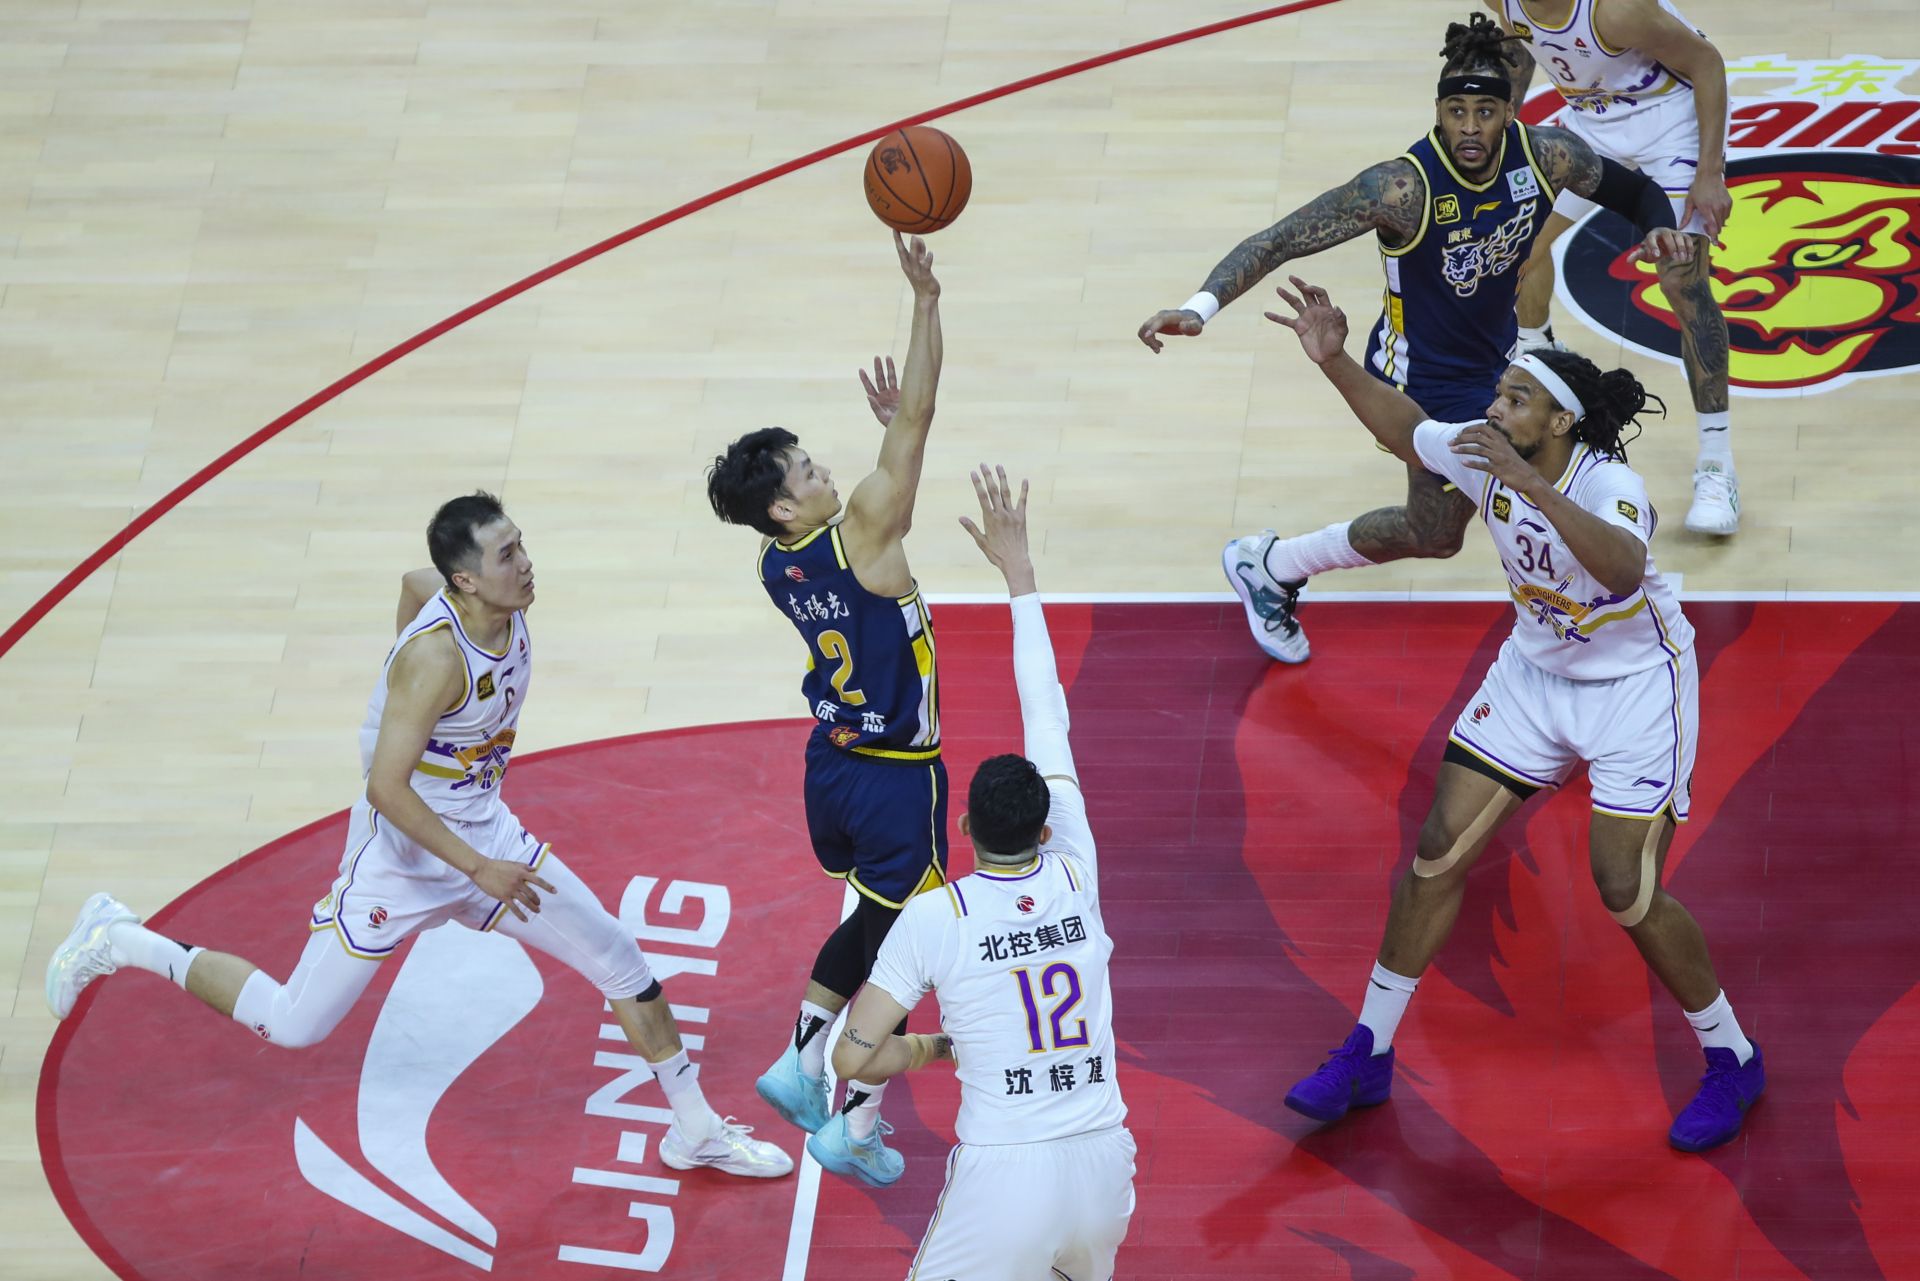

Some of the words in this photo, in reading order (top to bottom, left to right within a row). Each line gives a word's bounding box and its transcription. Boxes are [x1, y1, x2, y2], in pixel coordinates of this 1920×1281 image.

[1552, 56, 1576, 82] 3
[1516, 534, 1556, 580] 34
[817, 629, 867, 706] 2
[979, 915, 1086, 962] 北控集团
[1010, 960, 1090, 1053] 12
